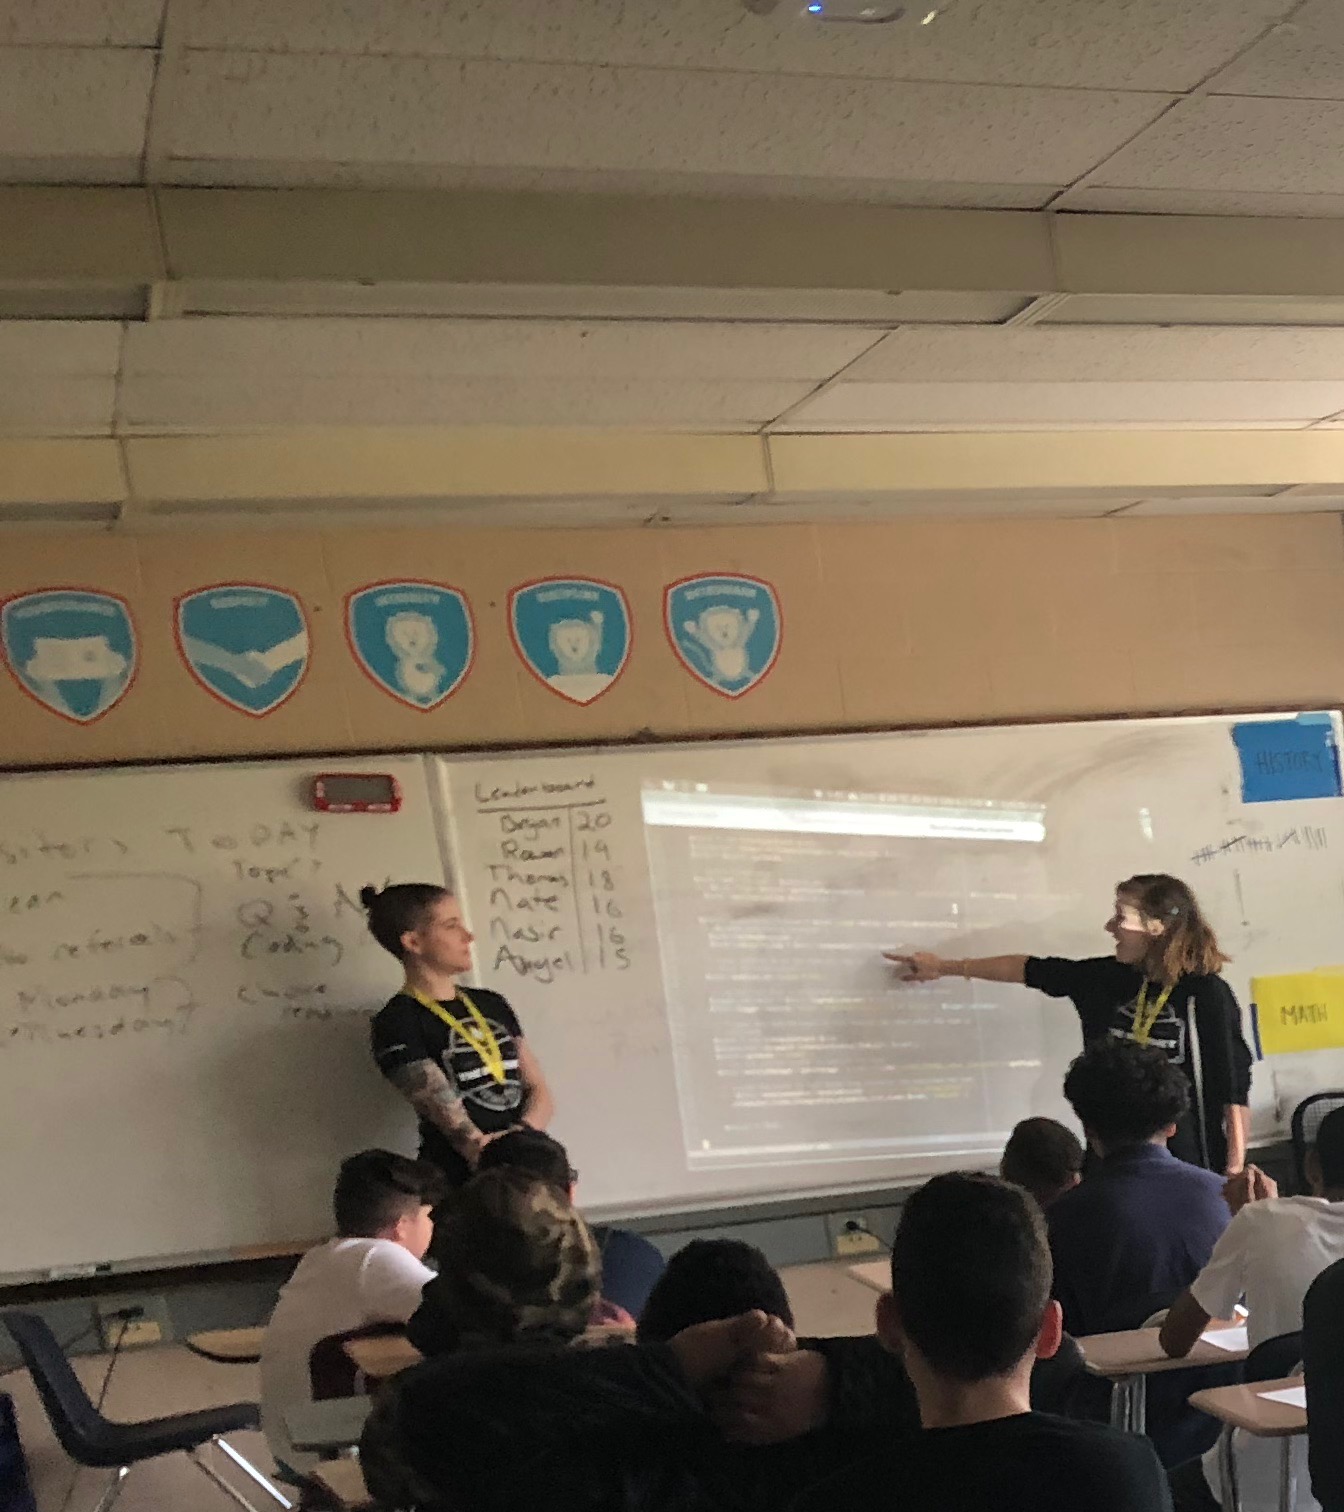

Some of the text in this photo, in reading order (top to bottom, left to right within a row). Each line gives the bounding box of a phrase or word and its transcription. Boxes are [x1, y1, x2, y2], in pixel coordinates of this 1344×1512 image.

[1255, 750, 1325, 775] HISTORY
[576, 810, 612, 832] 20
[588, 868, 615, 892] 18
[592, 894, 623, 918] 16
[1279, 1003, 1328, 1026] MATH
